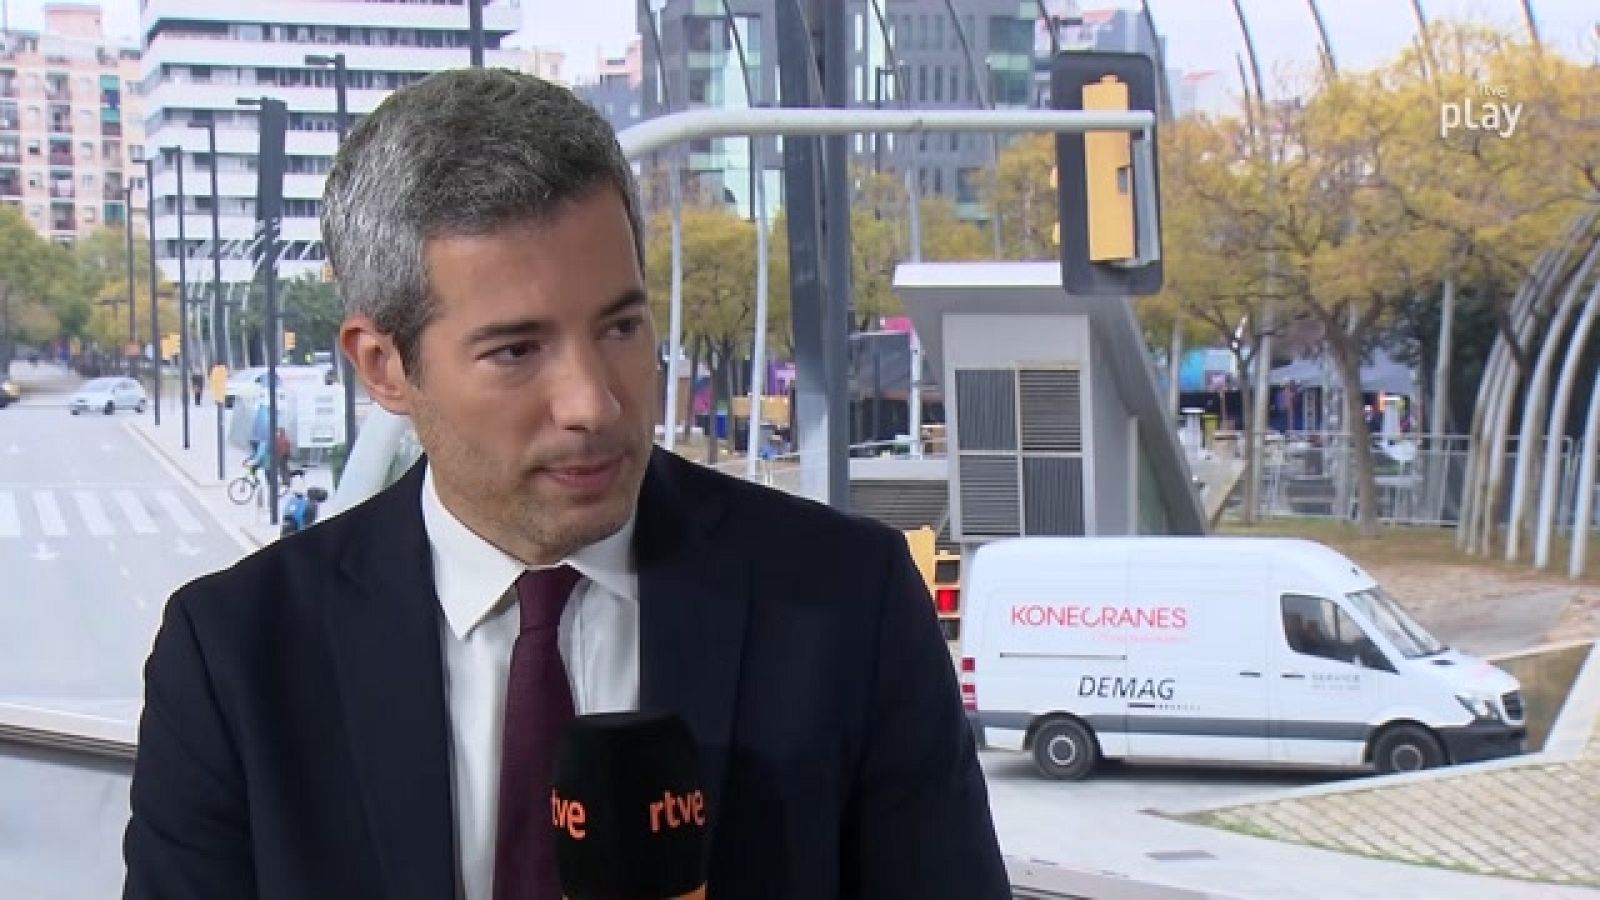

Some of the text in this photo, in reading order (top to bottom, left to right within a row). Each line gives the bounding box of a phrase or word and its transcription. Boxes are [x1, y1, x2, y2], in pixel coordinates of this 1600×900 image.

[1010, 604, 1189, 629] KONECRANES
[1078, 674, 1176, 701] DEMAG
[649, 789, 706, 833] rtve
